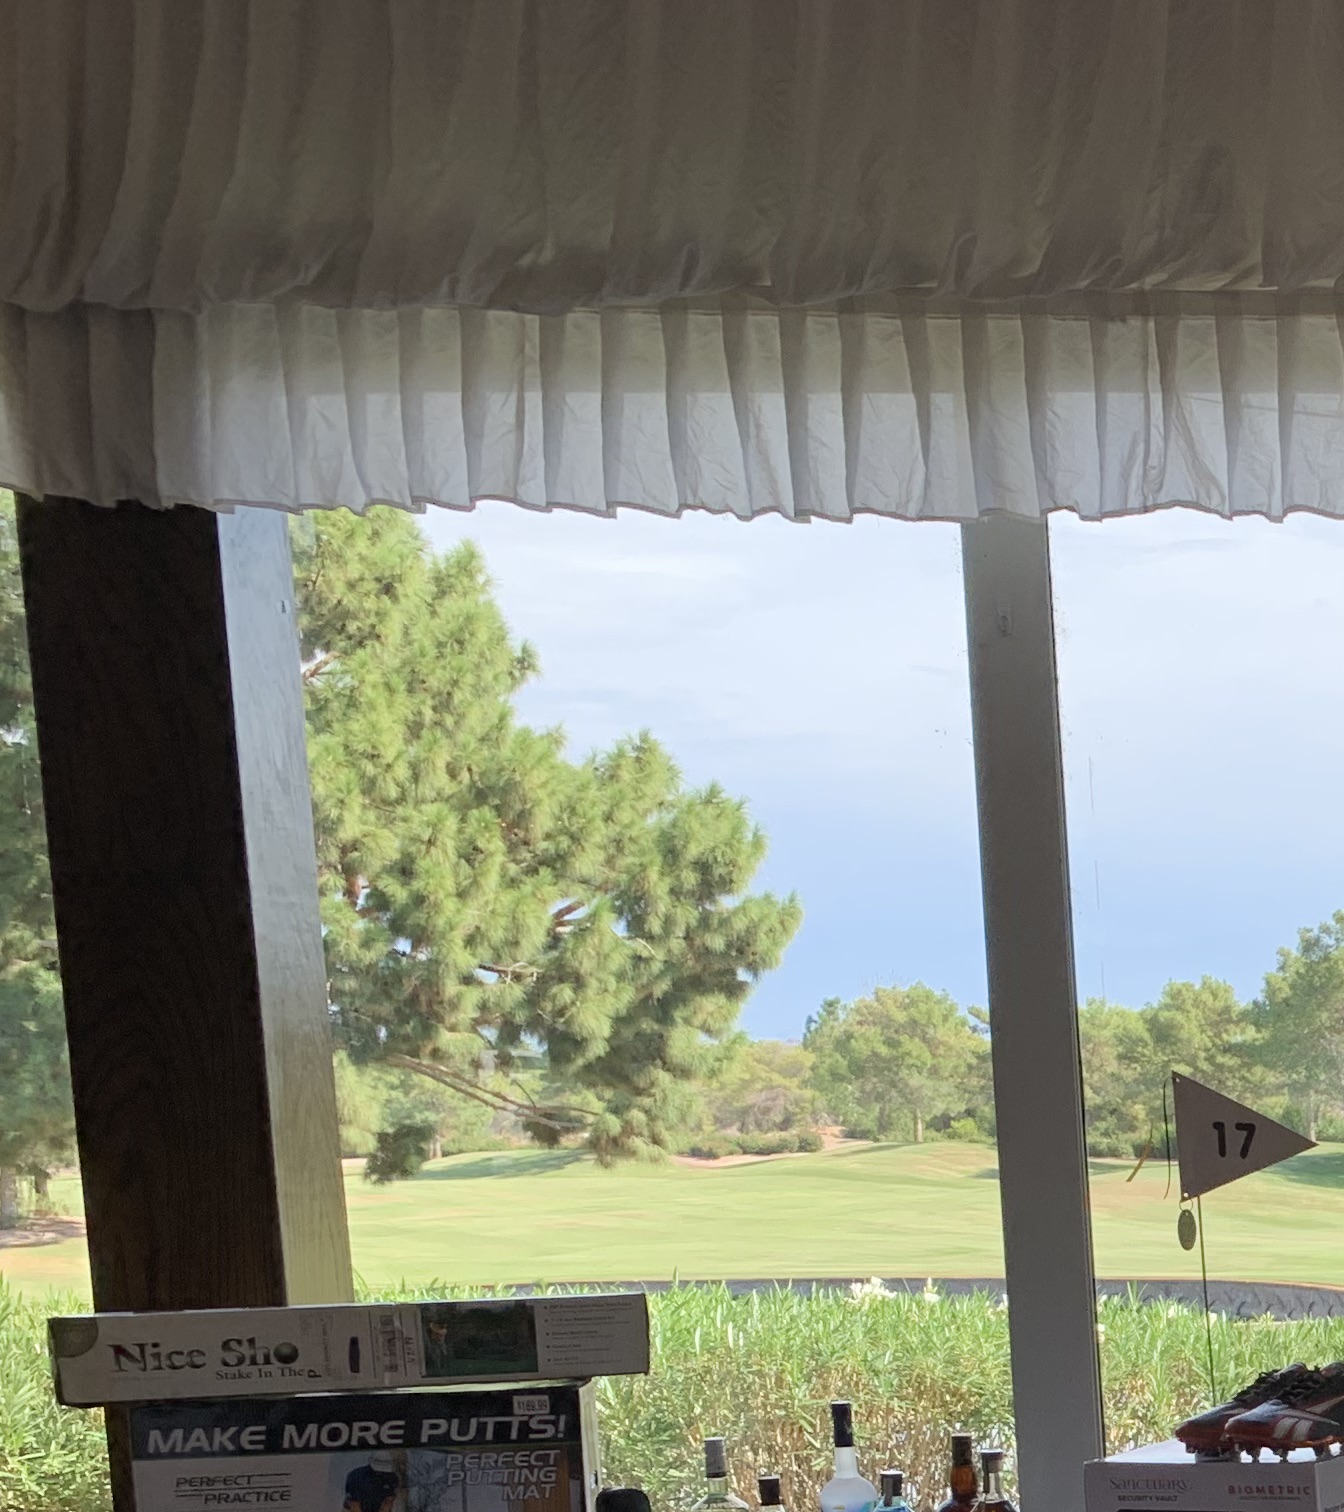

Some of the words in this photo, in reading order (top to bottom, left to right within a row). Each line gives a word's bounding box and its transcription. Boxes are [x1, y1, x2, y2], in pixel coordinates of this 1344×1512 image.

[1212, 1120, 1257, 1160] 17
[107, 1343, 207, 1373] Nice
[216, 1370, 252, 1382] Stake
[258, 1368, 273, 1379] In
[147, 1424, 267, 1455] MAKE
[281, 1419, 405, 1450] MORE
[419, 1413, 567, 1443] PUTTS!
[445, 1449, 561, 1469] PERFECT
[174, 1474, 254, 1489] PERFECT
[446, 1466, 557, 1486] PUTTING
[203, 1489, 292, 1505] PRACTICE
[501, 1484, 554, 1500] MAT
[1228, 1484, 1311, 1495] BIOMETRIC
